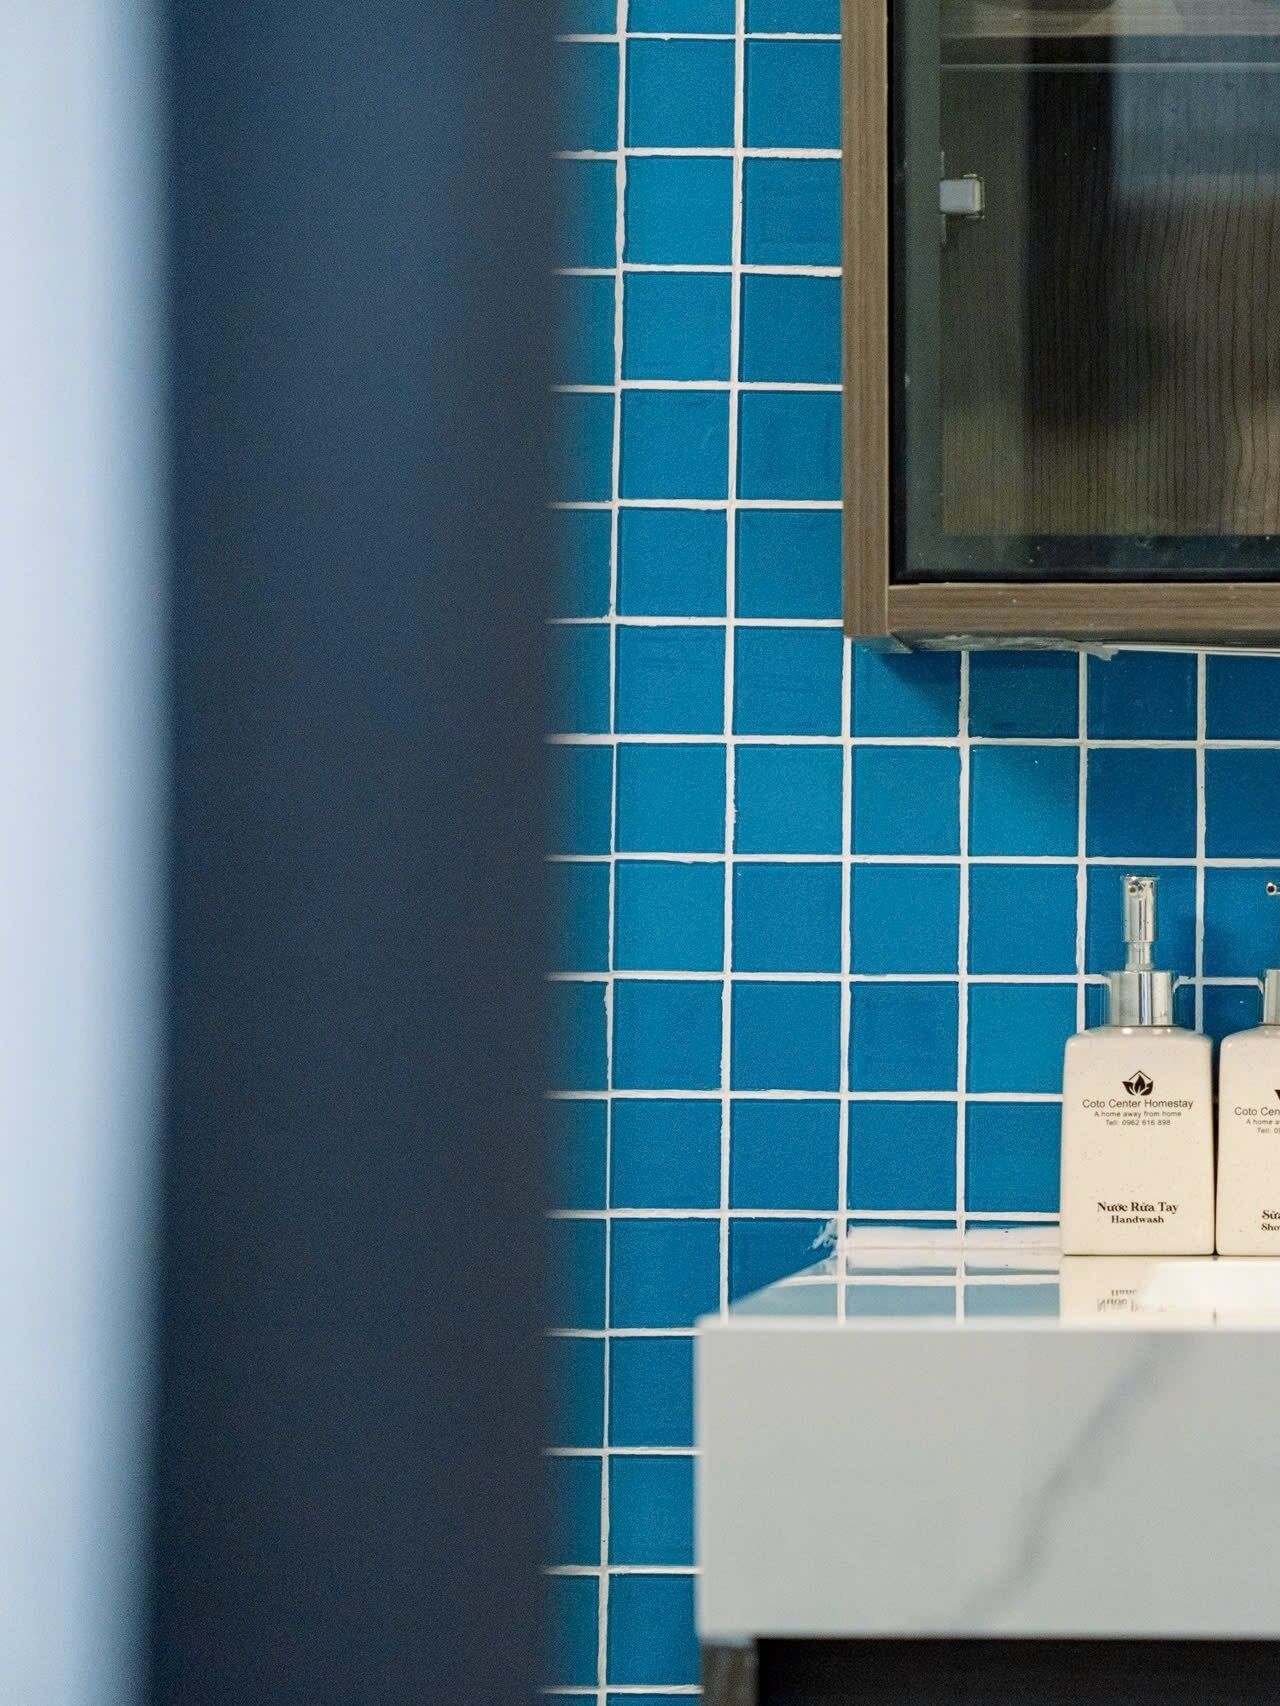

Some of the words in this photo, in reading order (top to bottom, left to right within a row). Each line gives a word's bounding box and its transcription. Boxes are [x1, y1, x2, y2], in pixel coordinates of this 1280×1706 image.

[1082, 1099, 1105, 1108] Coto
[1108, 1099, 1141, 1108] Center
[1144, 1099, 1193, 1111] Homestay
[1234, 1107, 1258, 1116] Coto
[1097, 1201, 1128, 1212] Nước
[1158, 1201, 1179, 1214] Tay
[1111, 1215, 1165, 1223] Handwash
